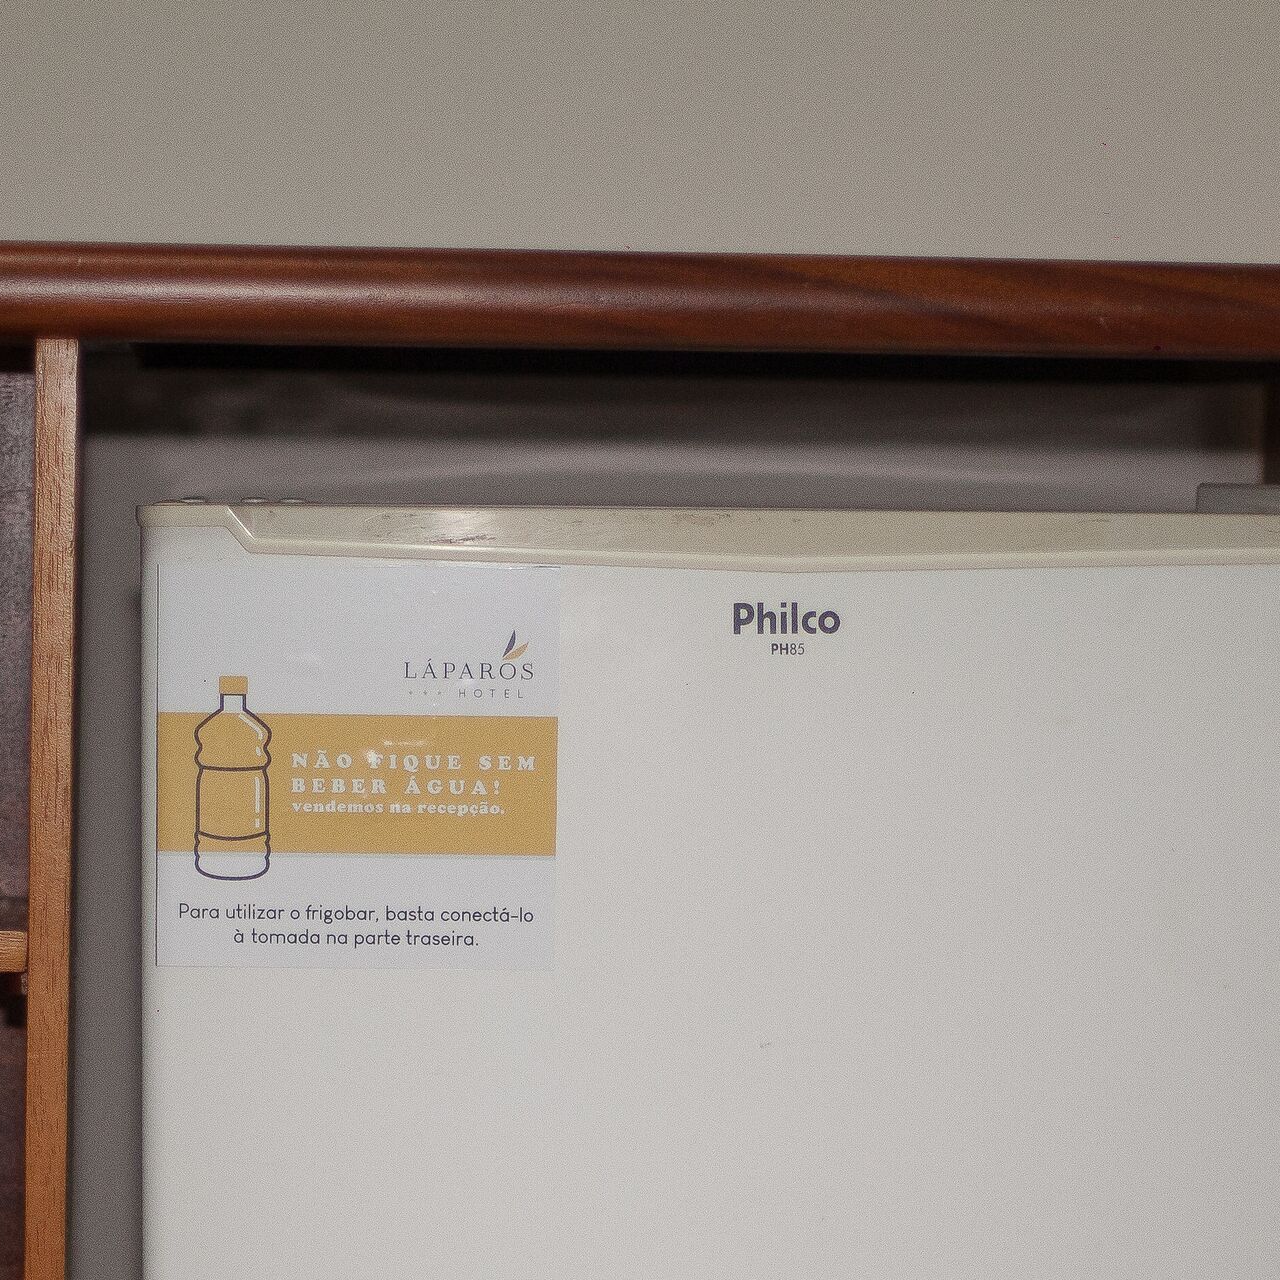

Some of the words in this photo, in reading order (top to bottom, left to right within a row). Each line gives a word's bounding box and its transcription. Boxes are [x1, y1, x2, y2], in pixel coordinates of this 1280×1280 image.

[733, 602, 841, 635] Philco
[771, 643, 805, 655] PH85
[404, 658, 534, 680] LÁPAROS
[458, 688, 524, 698] HOTEL
[291, 750, 354, 769] NÃO
[370, 753, 462, 772] FIQUE
[478, 754, 537, 771] SEM
[291, 777, 388, 794] BEBER
[404, 775, 501, 795] ÁGUA!
[291, 800, 384, 814] vendemos
[389, 803, 412, 814] na
[417, 801, 505, 817] recepção.
[178, 902, 220, 919] Para
[225, 903, 285, 920] utilizar
[289, 908, 301, 920] o
[305, 904, 379, 924] frigobar,
[386, 905, 435, 922] basta
[440, 906, 535, 923] conectá-lo
[233, 929, 245, 944] à
[251, 928, 321, 945] tomada
[326, 933, 348, 945] na
[353, 931, 401, 949] parte
[406, 930, 480, 947] traseira.
